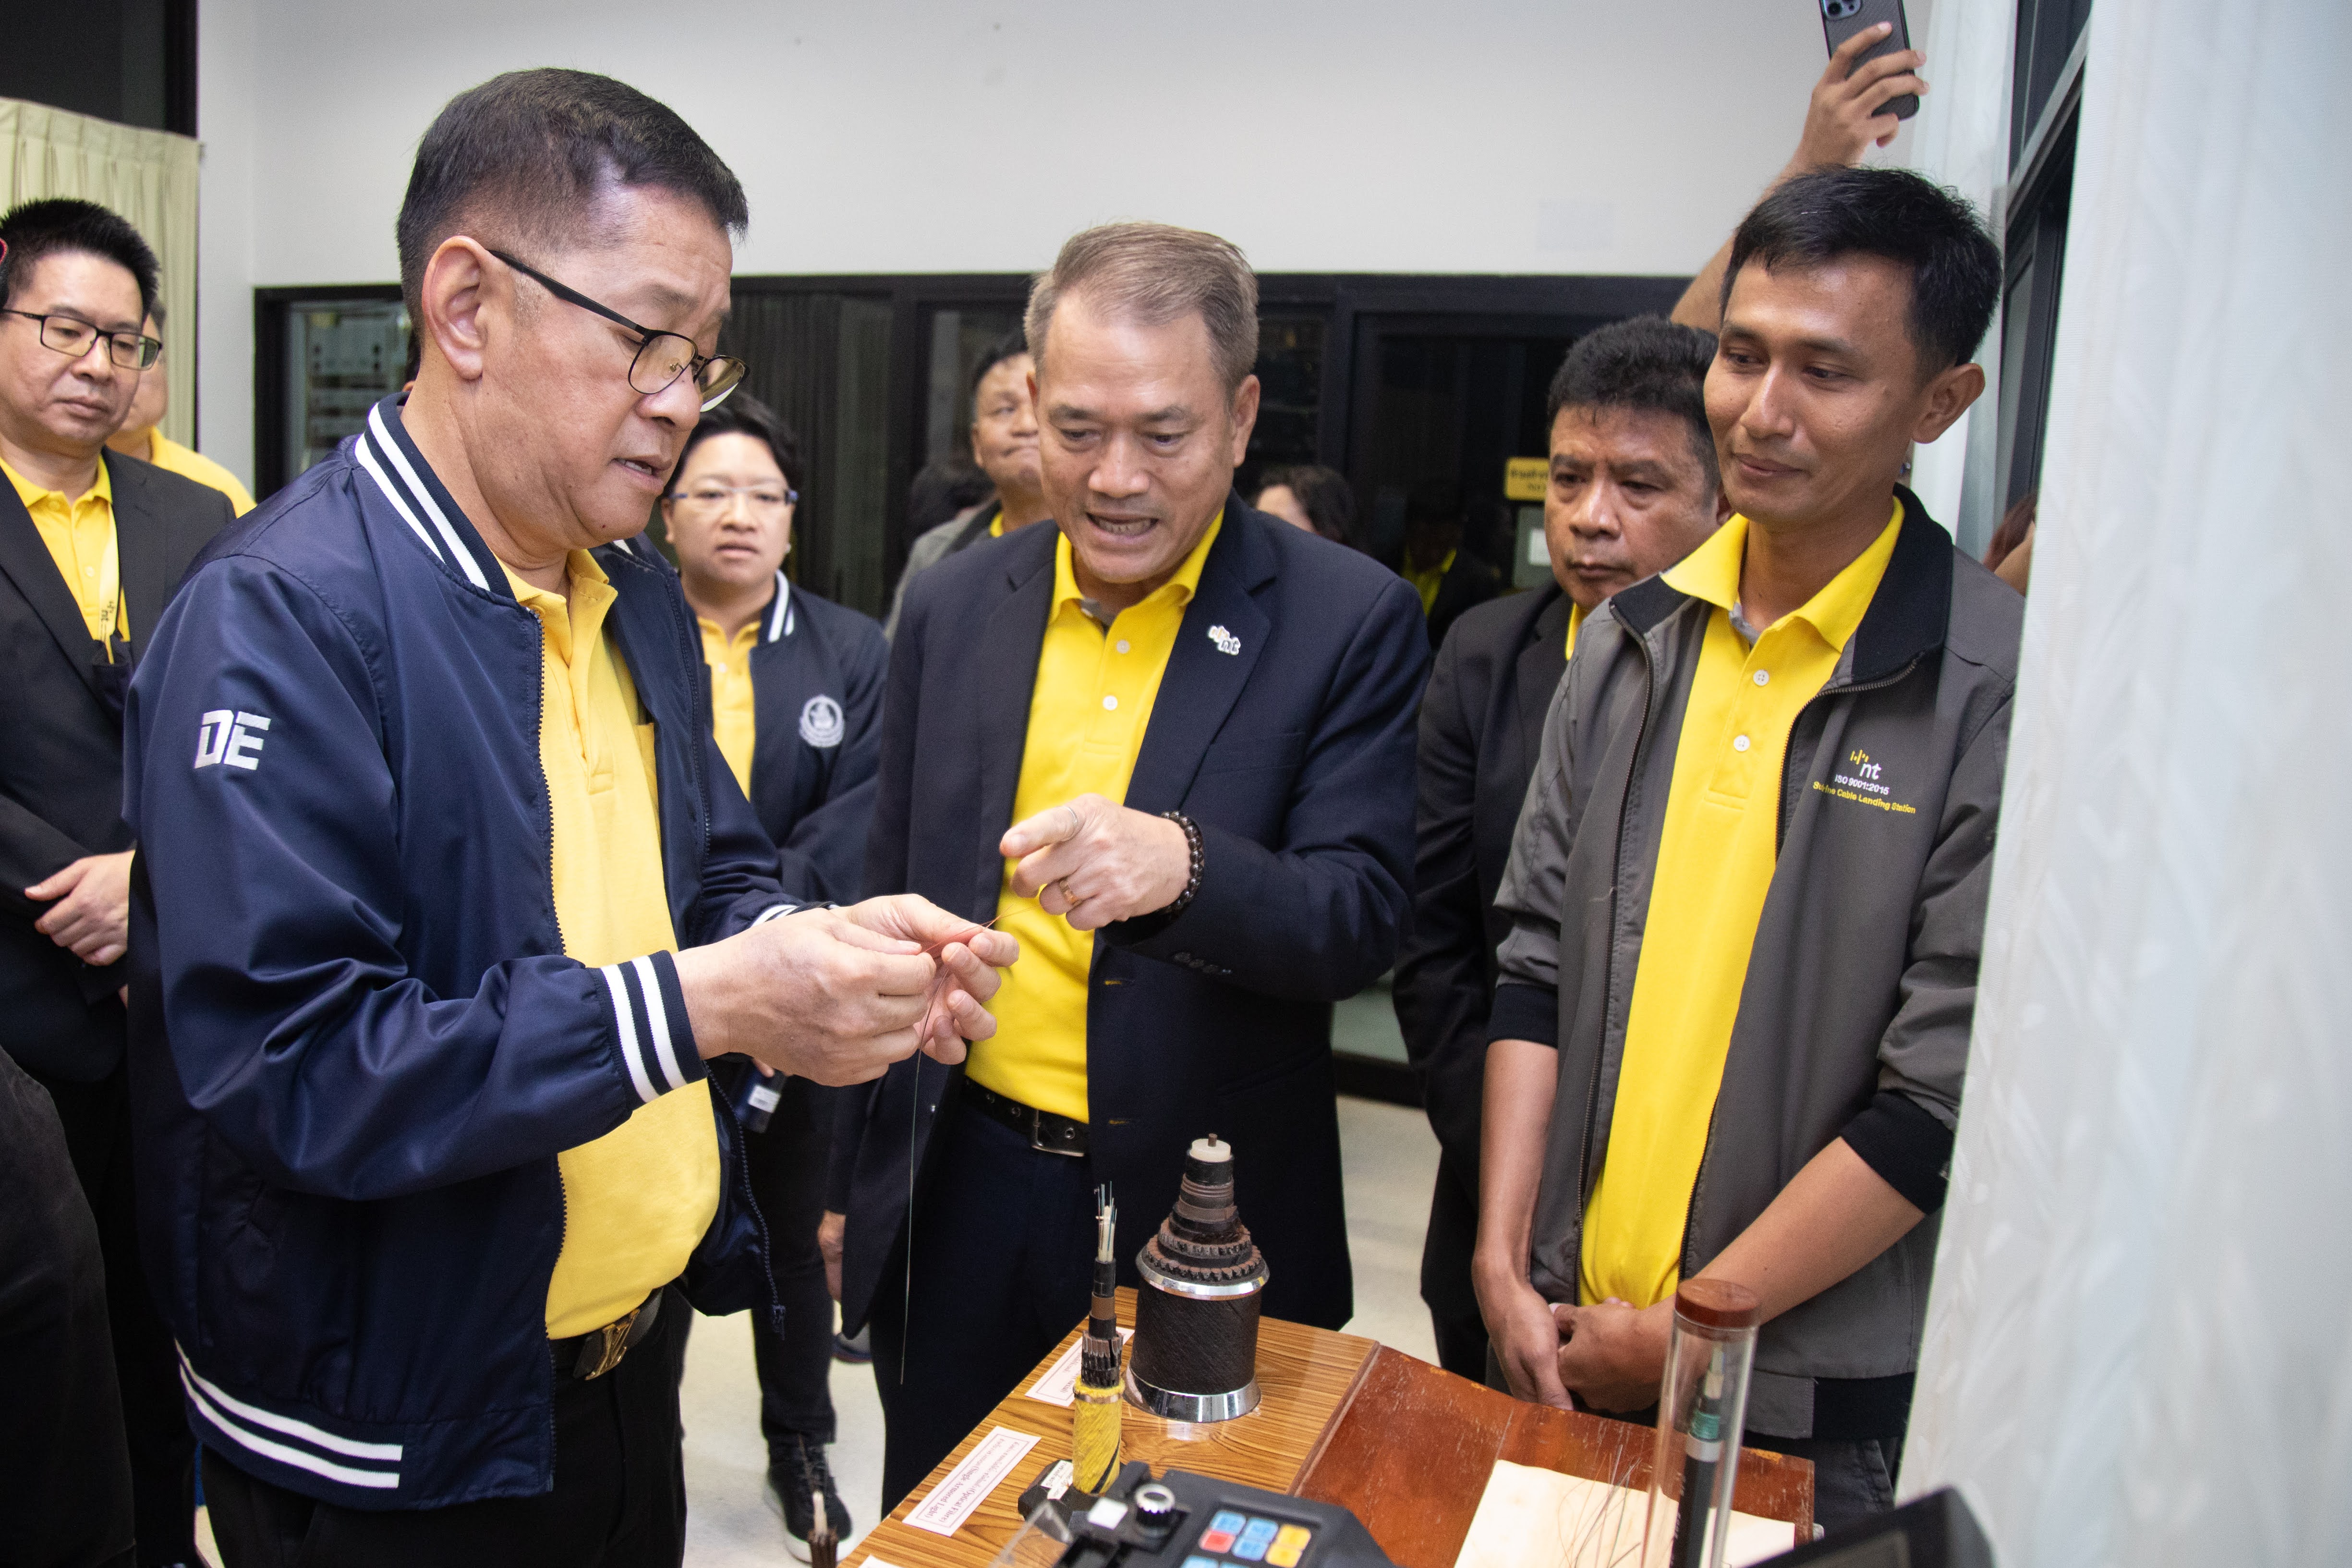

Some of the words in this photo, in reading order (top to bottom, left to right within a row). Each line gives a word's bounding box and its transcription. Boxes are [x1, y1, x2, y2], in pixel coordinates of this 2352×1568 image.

[194, 709, 271, 770] DE
[1859, 763, 1881, 780] nt
[1835, 775, 1847, 784] ISO
[1848, 778, 1890, 795] 9001:2015
[1837, 789, 1856, 801] Cable
[1858, 794, 1890, 811] Landing
[1891, 802, 1916, 814] Station
[941, 1482, 964, 1502] Armored
